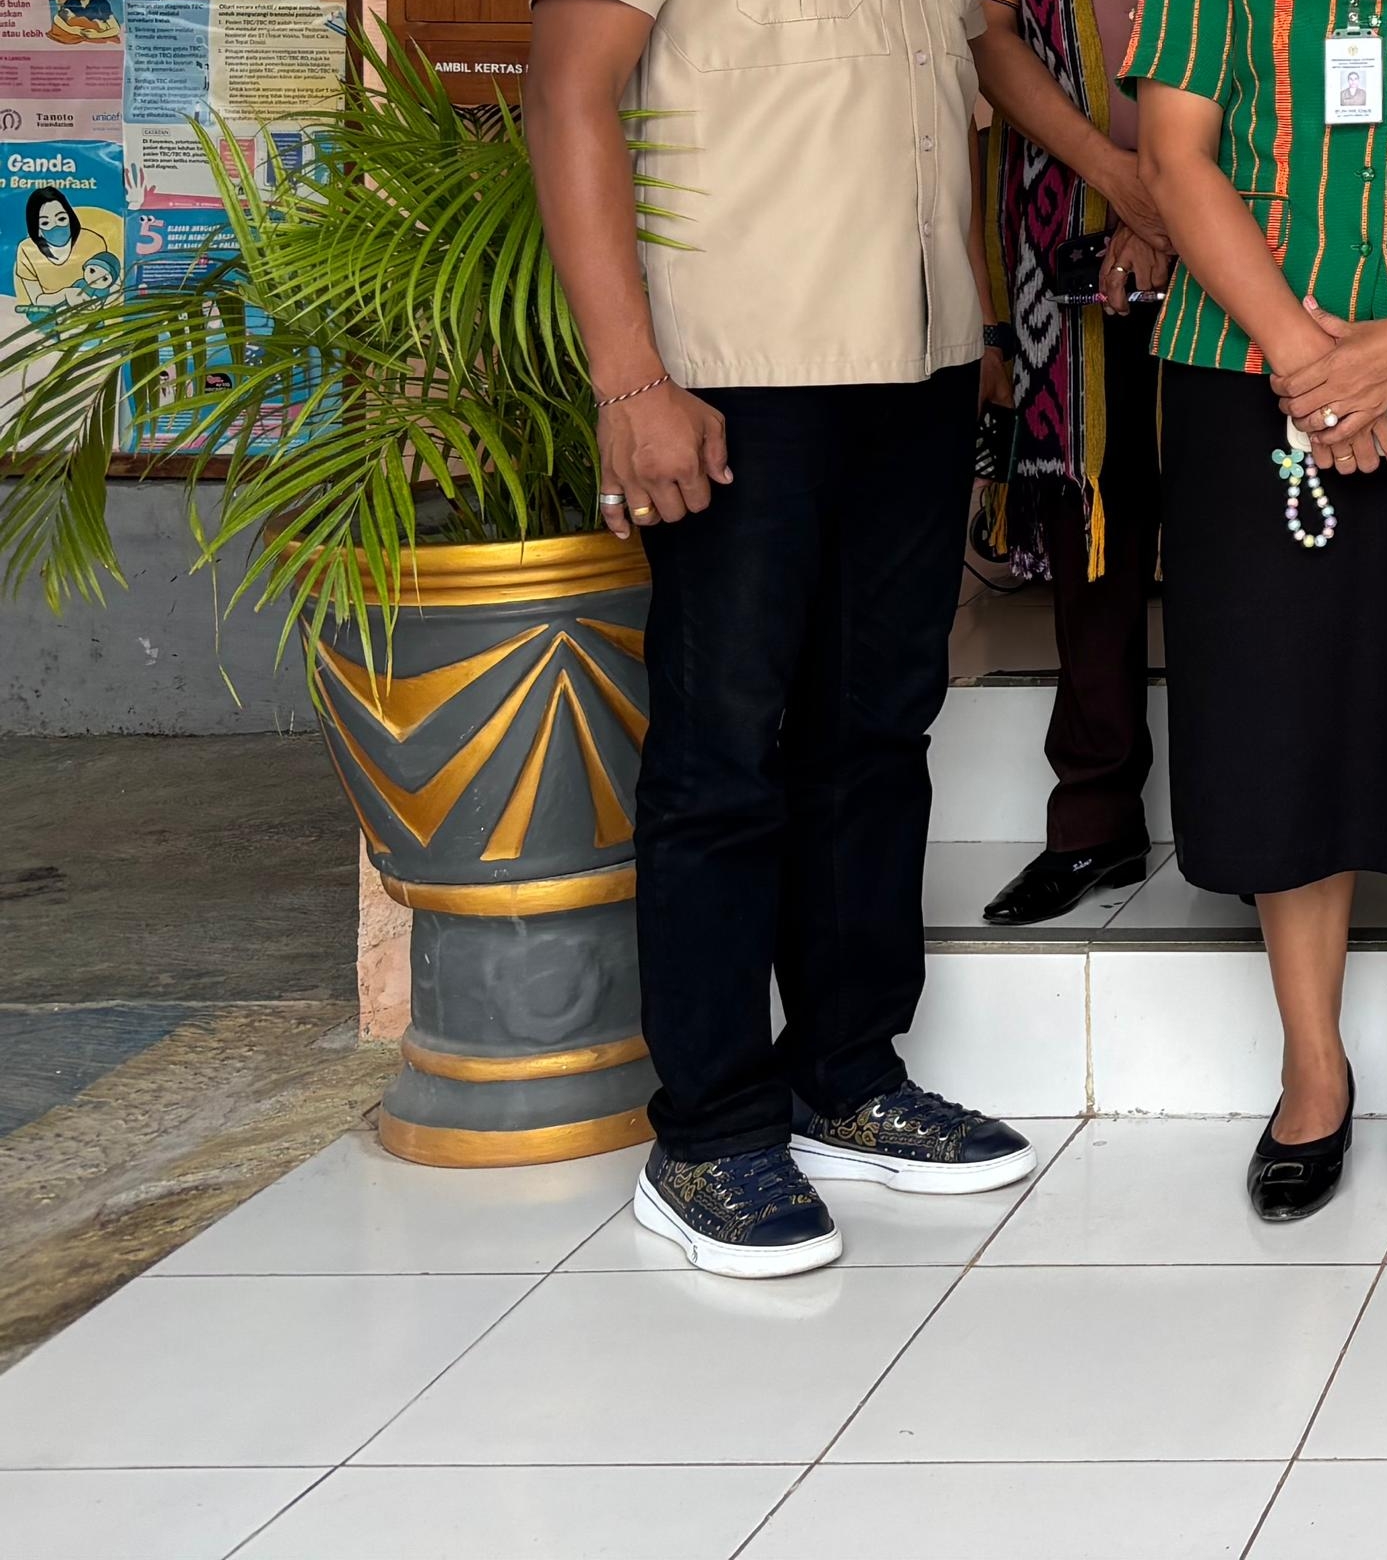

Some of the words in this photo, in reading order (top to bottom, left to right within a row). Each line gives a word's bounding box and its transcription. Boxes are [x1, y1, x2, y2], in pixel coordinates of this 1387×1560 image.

[7, 0, 31, 8] bulan
[22, 29, 44, 38] lebih
[435, 62, 471, 73] AMBIL
[474, 63, 523, 74] KERTAS
[36, 113, 74, 121] Tanoto
[7, 153, 77, 172] Ganda
[10, 176, 98, 189] Bermanfaat
